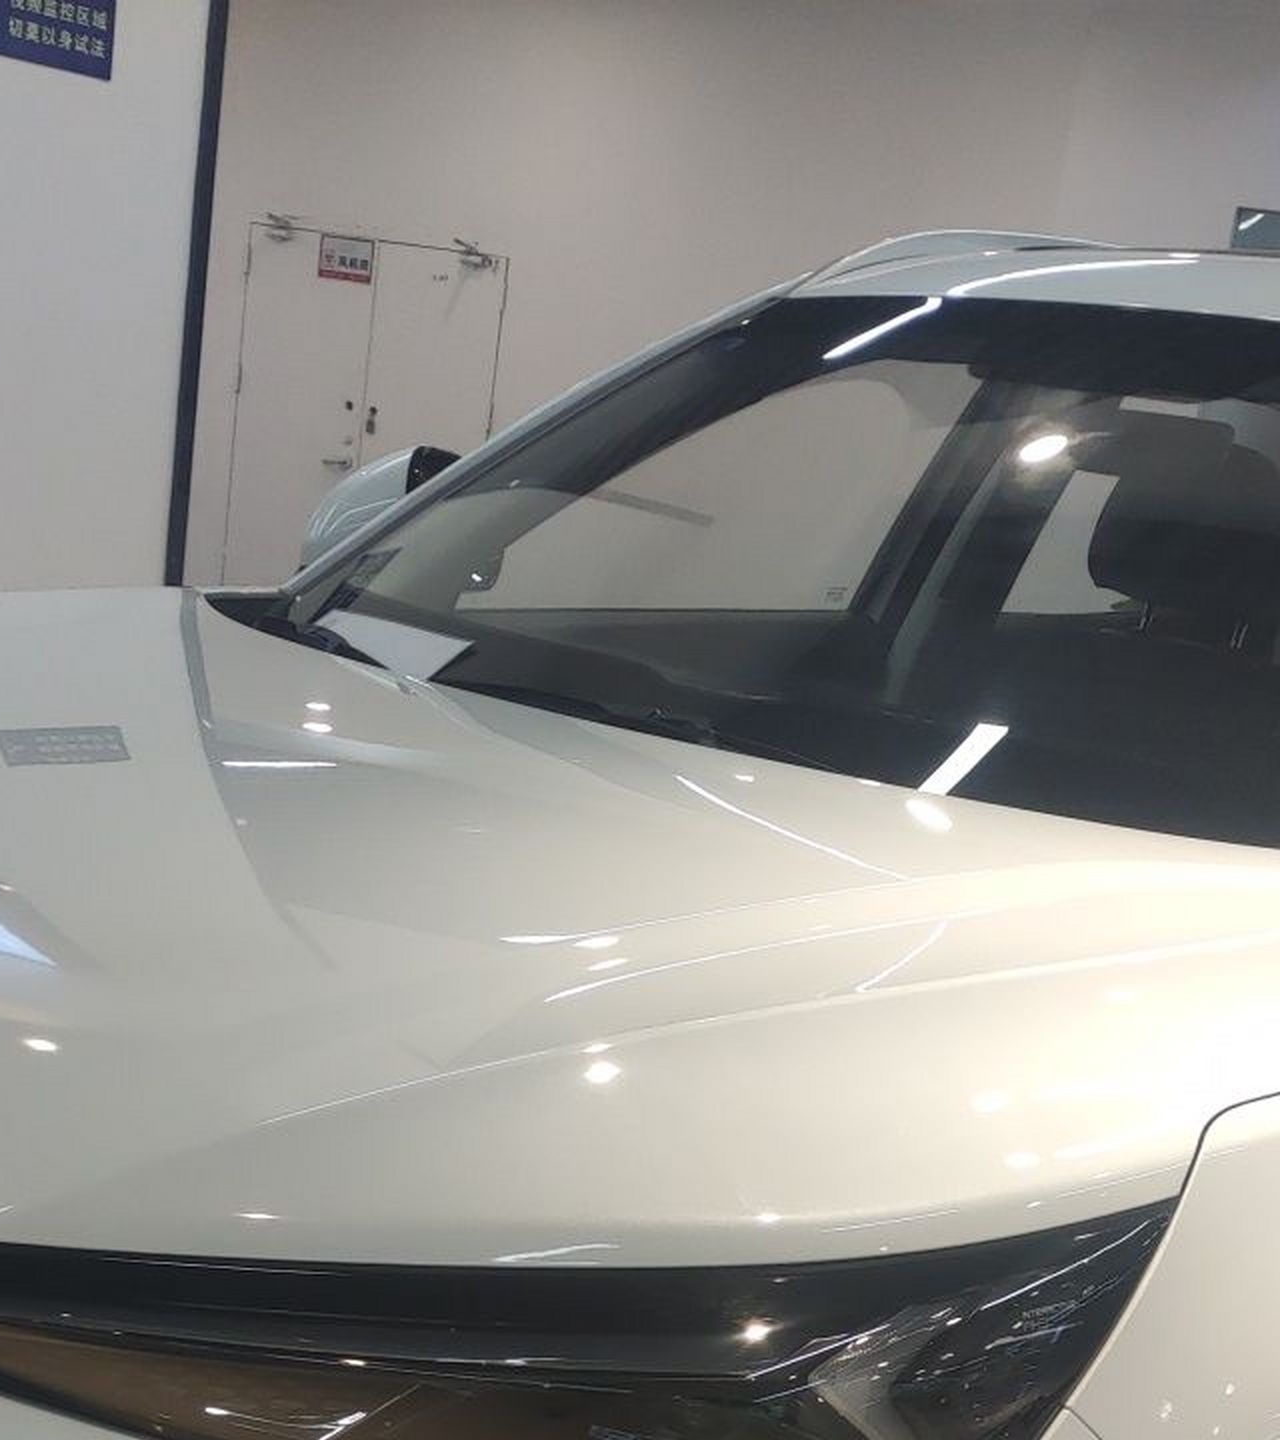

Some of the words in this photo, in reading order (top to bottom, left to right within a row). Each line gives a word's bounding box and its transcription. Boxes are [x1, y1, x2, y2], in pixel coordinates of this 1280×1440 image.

[8, 16, 106, 58] 切莫以身试法
